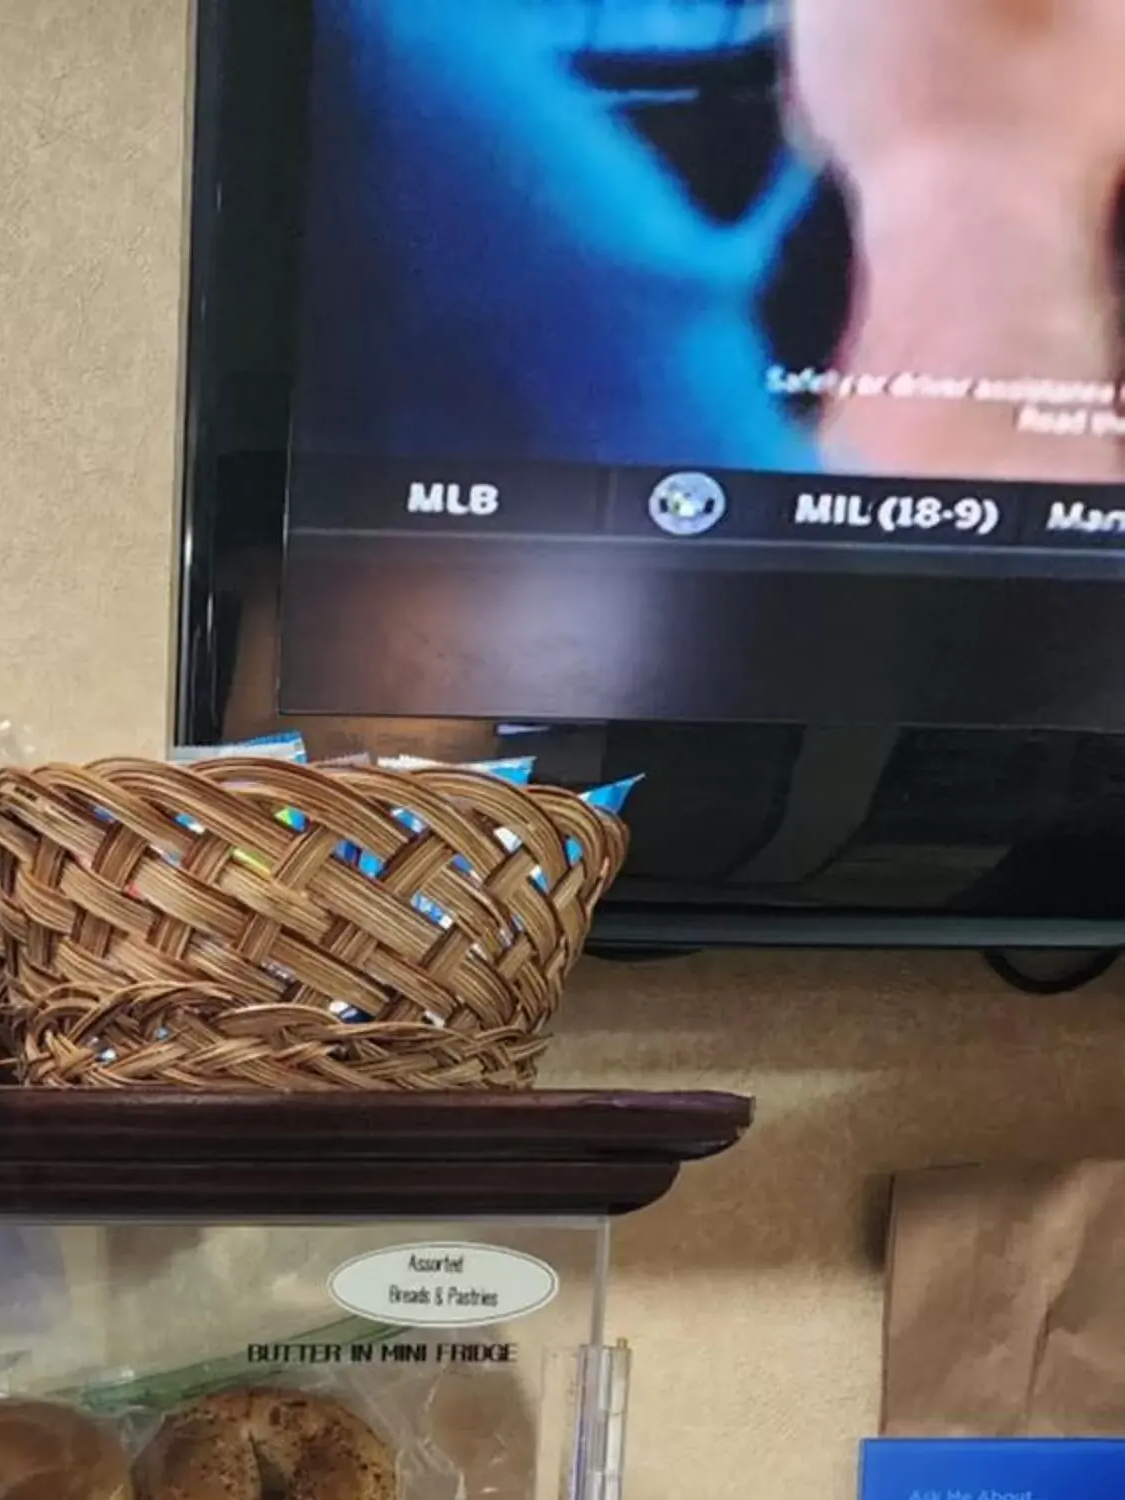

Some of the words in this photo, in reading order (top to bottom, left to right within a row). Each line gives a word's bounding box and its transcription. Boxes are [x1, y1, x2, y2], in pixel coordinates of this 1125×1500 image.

[407, 482, 499, 515] MLB
[794, 493, 872, 527] MIL
[877, 495, 999, 535] (18-9)
[407, 1254, 464, 1274] Assorted
[388, 1285, 431, 1304] Breads
[447, 1287, 499, 1307] Pastries
[247, 1344, 341, 1363] BUTTER
[350, 1344, 373, 1363] IN
[381, 1344, 428, 1363] MINI
[435, 1344, 518, 1363] FRIDGE
